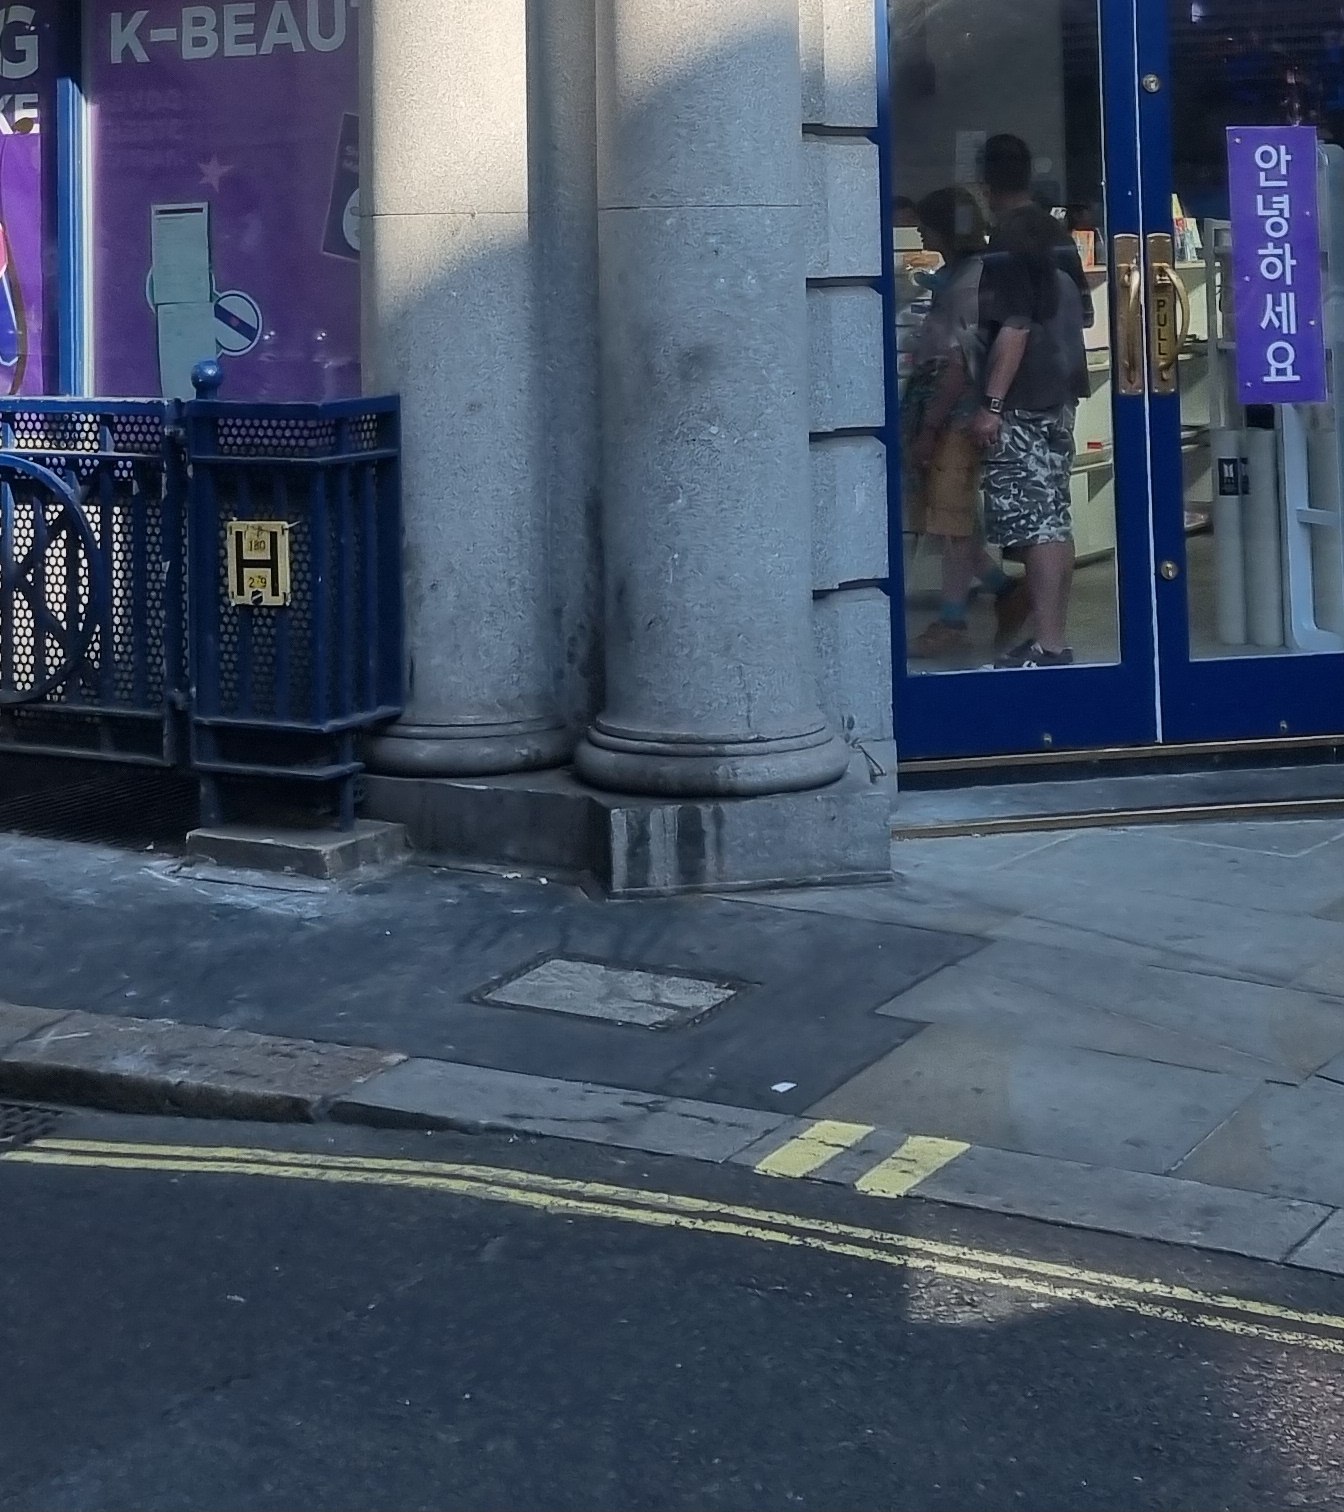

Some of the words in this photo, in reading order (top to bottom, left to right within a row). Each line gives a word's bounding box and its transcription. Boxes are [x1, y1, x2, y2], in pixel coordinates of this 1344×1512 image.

[1254, 144, 1301, 383] 안녕하세요
[1157, 299, 1167, 356] PULL
[235, 531, 280, 597] H
